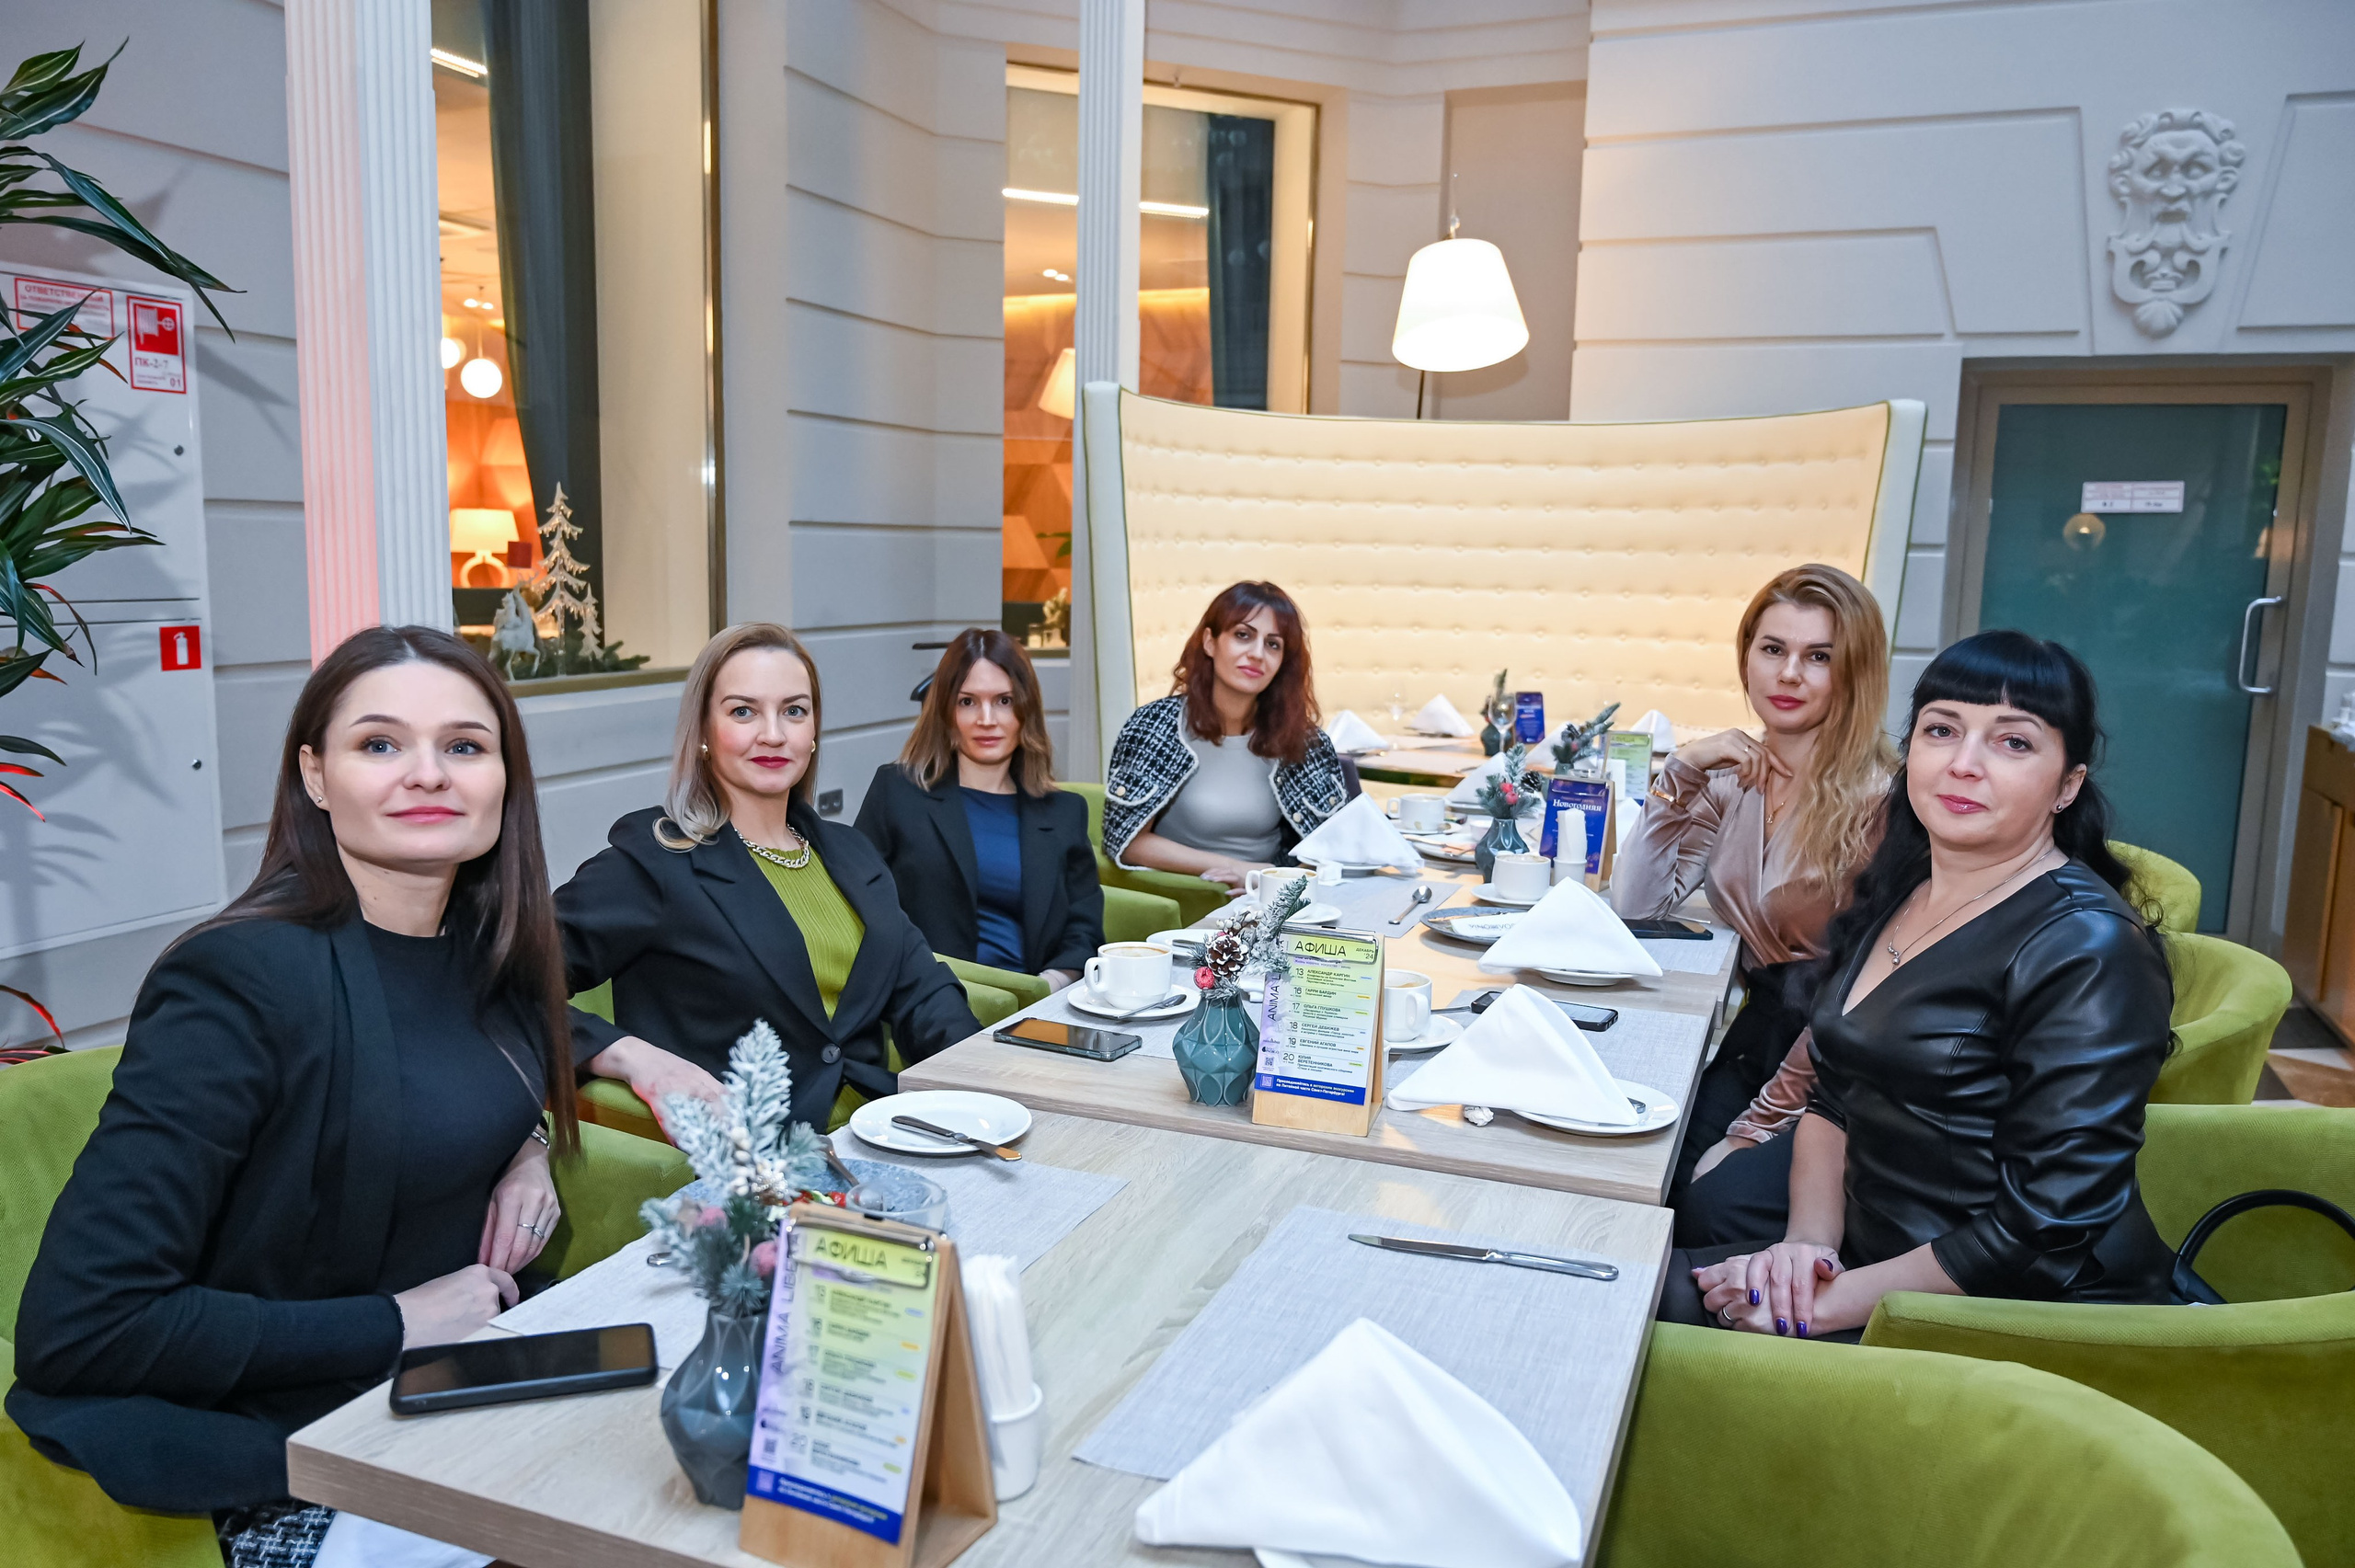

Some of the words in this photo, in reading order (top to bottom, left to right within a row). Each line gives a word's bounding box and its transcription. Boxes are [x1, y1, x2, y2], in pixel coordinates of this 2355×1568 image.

[1553, 798, 1602, 812] Новогодняя
[1294, 941, 1347, 956] АФИША
[1295, 967, 1304, 976] 13
[1268, 985, 1280, 1022] ANIMA
[814, 1236, 888, 1270] АФИША
[770, 1311, 790, 1374] ANIMA
